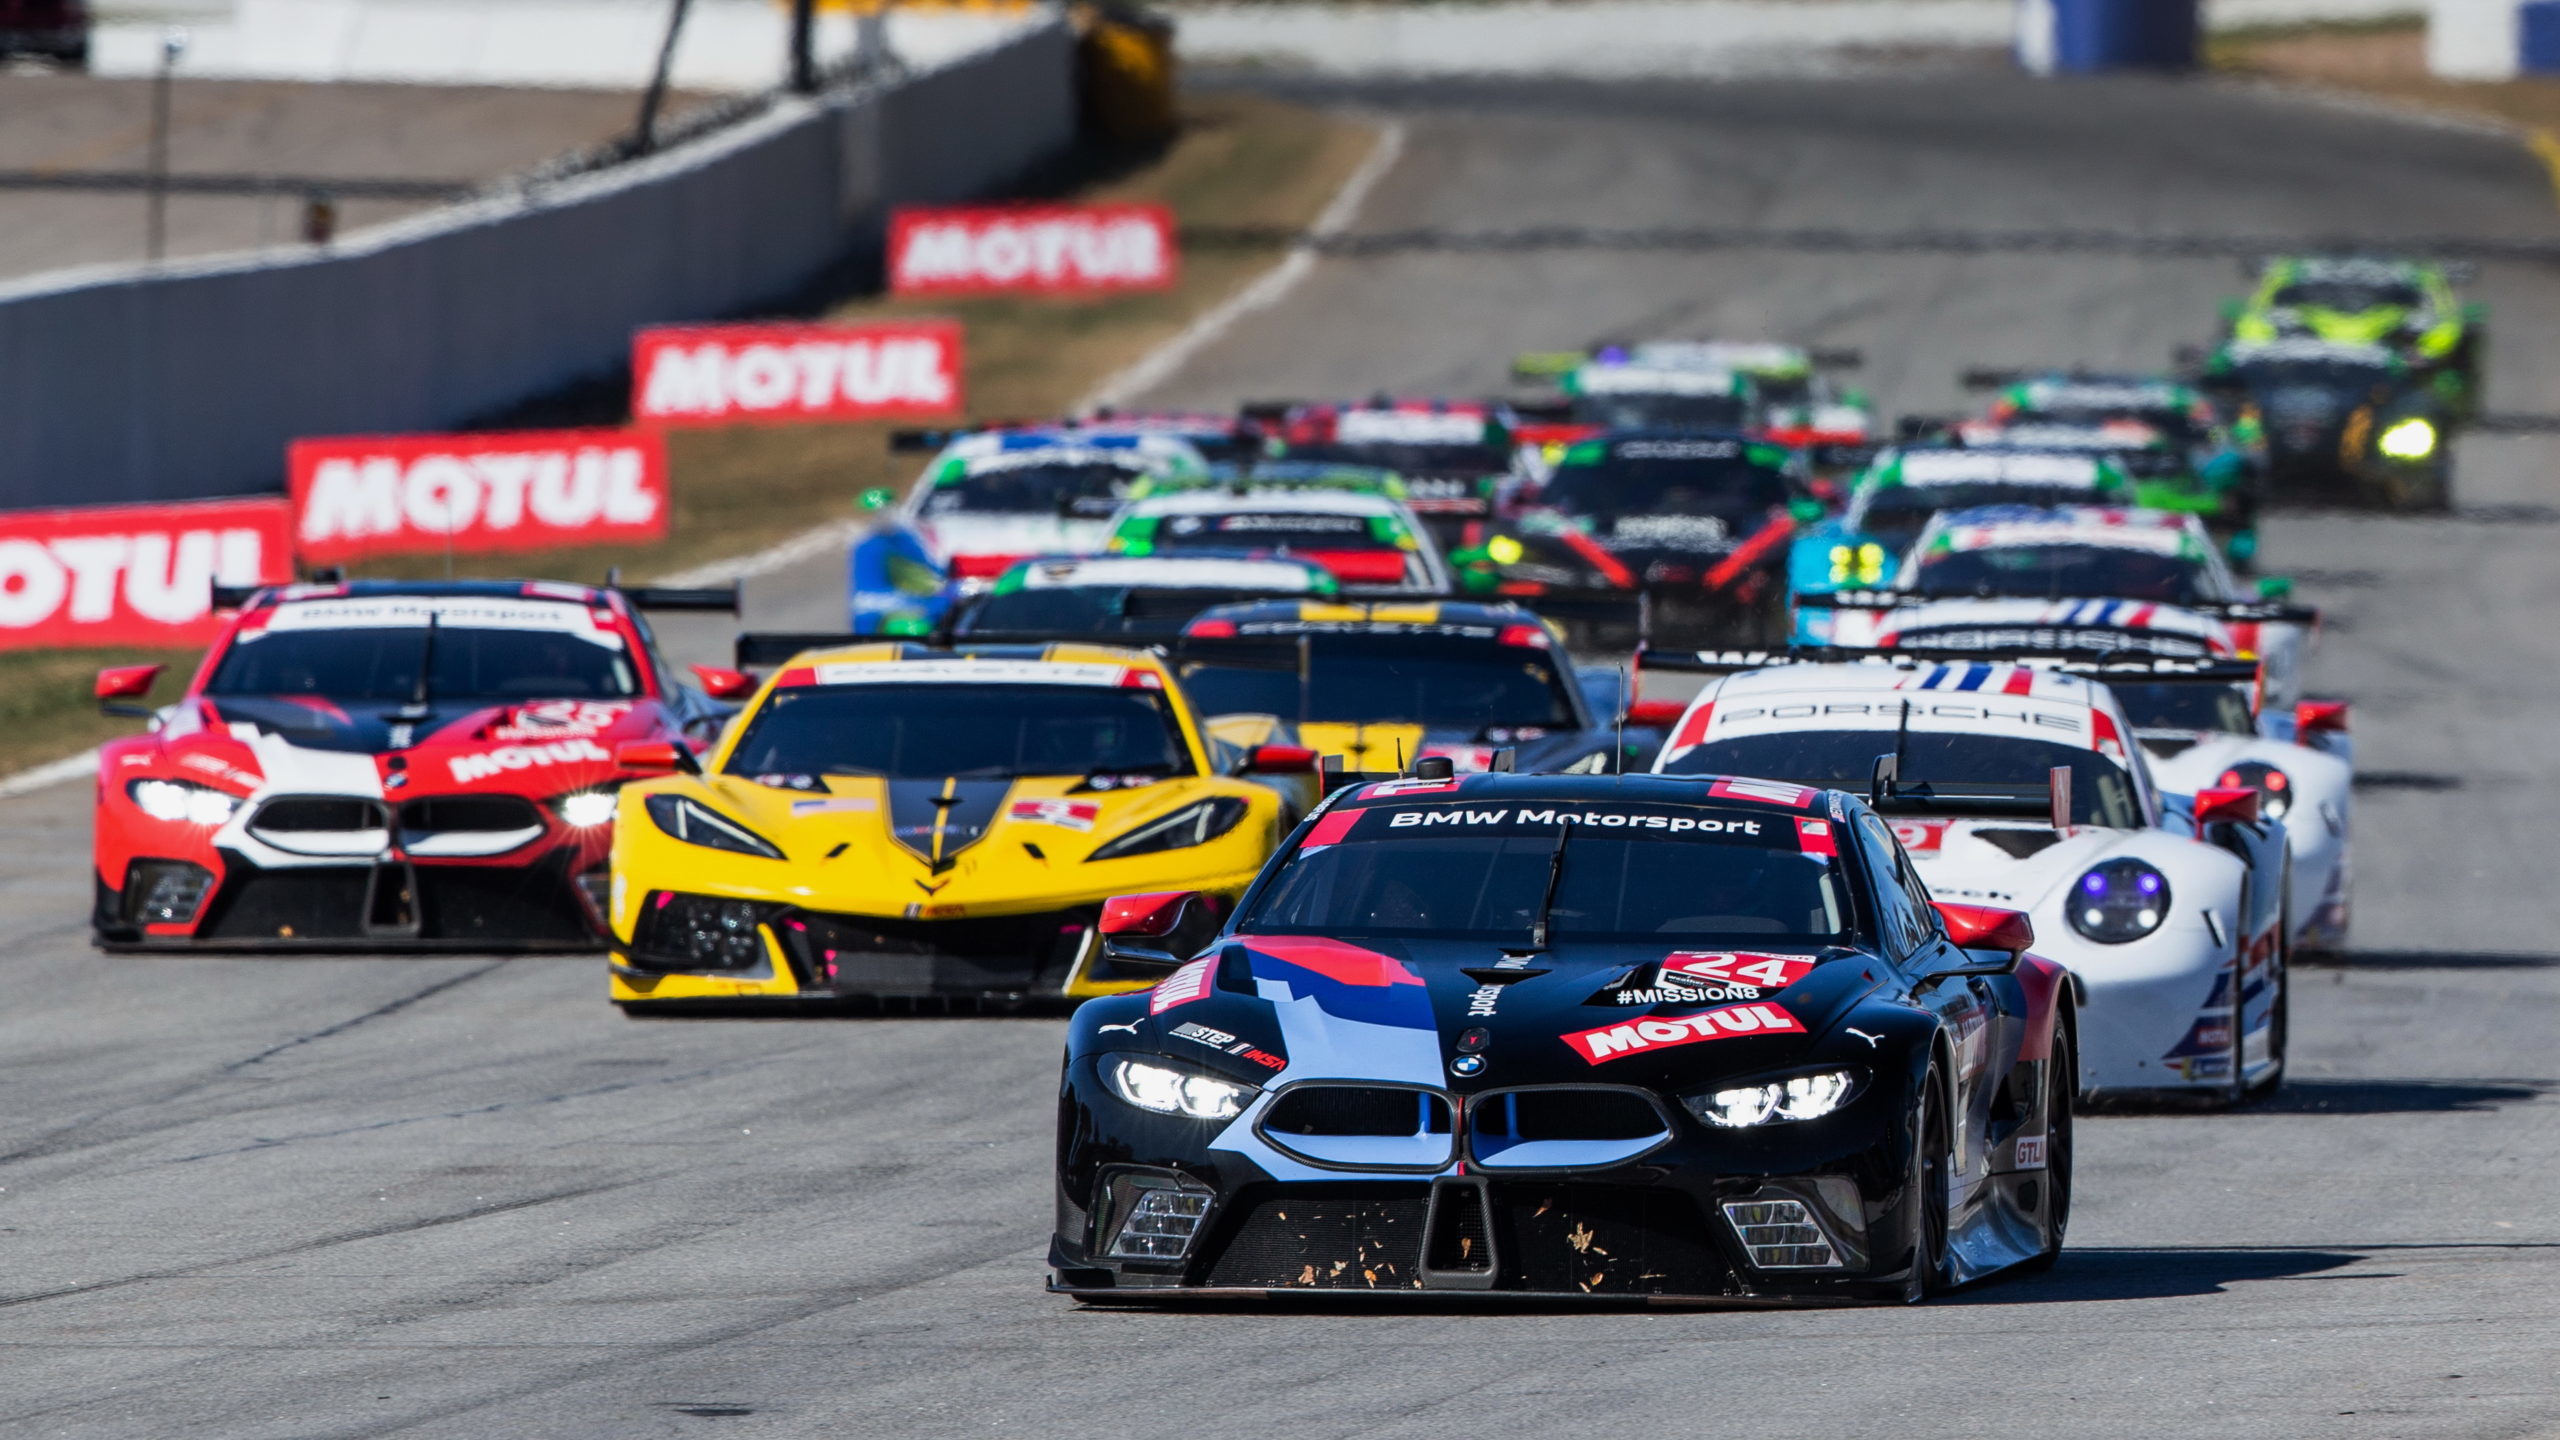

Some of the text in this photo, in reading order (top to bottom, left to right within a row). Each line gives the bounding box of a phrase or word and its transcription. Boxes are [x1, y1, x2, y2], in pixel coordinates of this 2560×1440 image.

[645, 338, 950, 412] MOTUL
[302, 446, 657, 541] MOTUL
[1720, 703, 2084, 733] PORSCHE
[449, 738, 611, 784] MOTUL
[1389, 809, 1761, 836] BMW Motorsport
[1888, 824, 1928, 850] 9
[1682, 953, 1788, 987] 24
[1616, 987, 1760, 1005] #MISSION8
[1191, 1027, 1236, 1045] STEP
[1585, 1011, 1792, 1058] MOTUL
